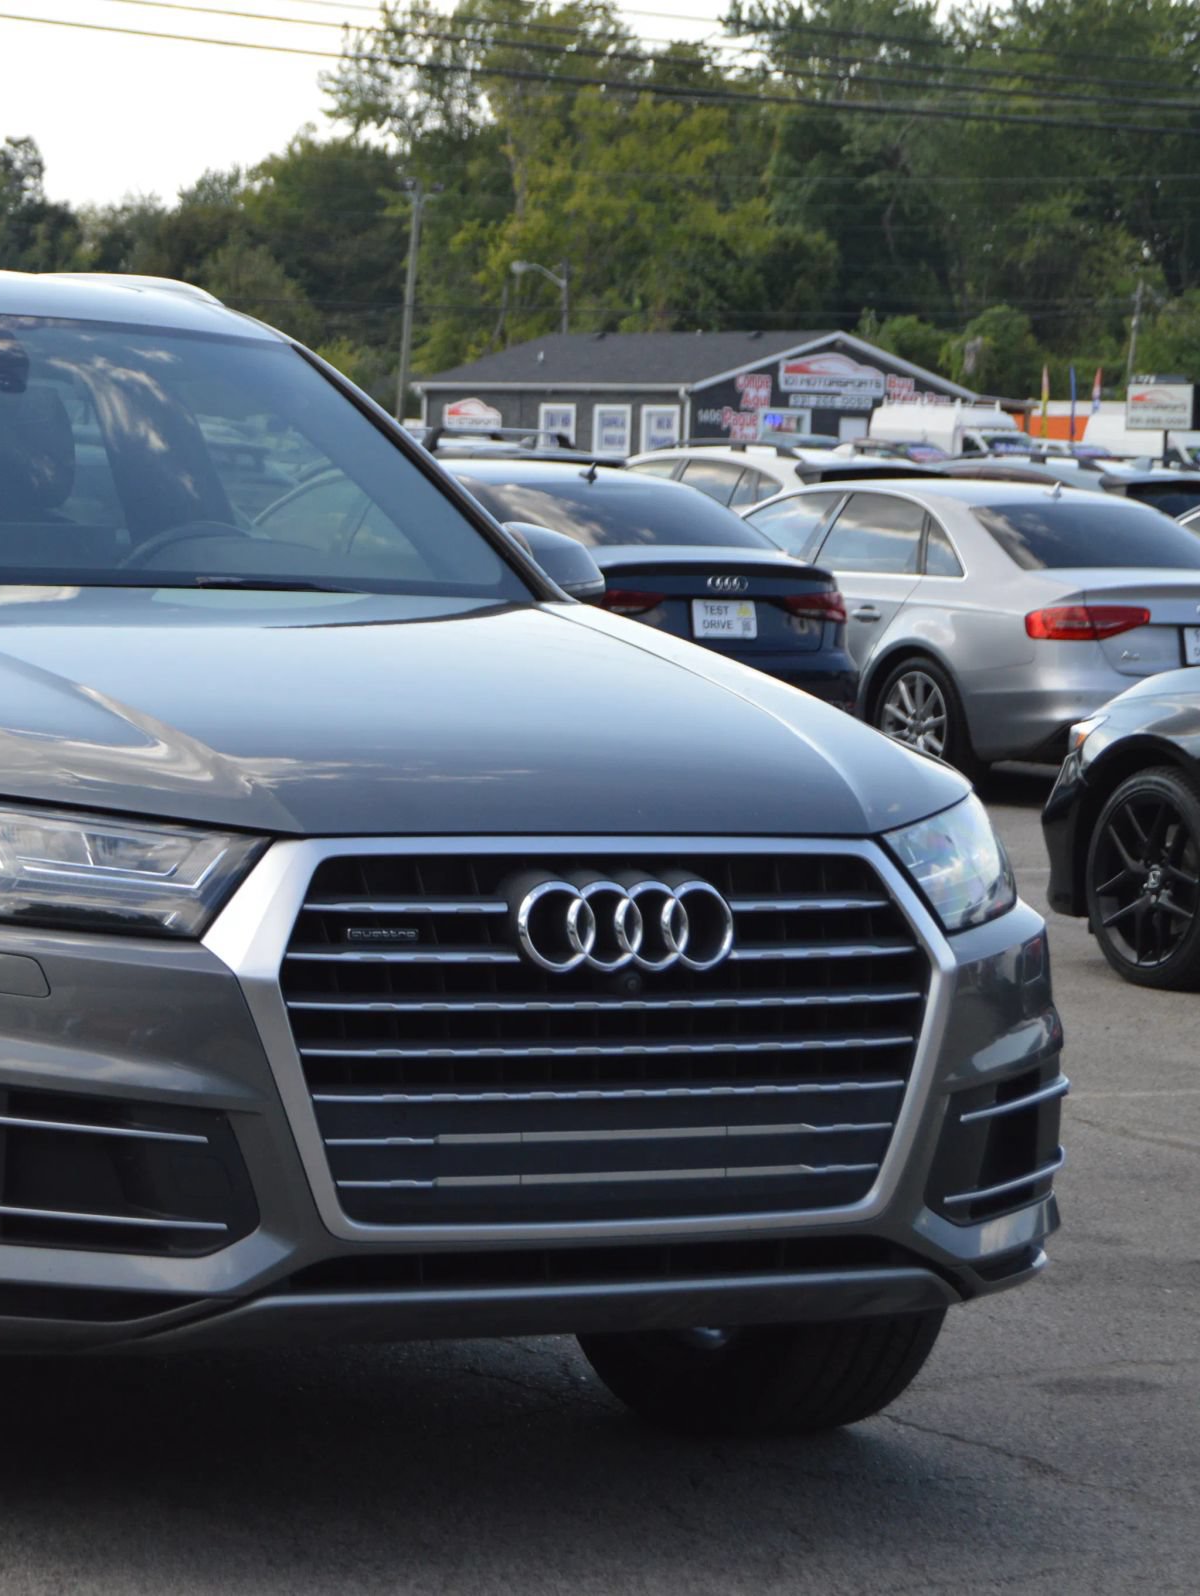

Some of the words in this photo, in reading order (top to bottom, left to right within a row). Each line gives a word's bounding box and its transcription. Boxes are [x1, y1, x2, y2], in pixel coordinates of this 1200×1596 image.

[800, 377, 882, 389] MOTORSPORTS
[704, 605, 729, 616] TEST
[702, 619, 734, 630] DRIVE
